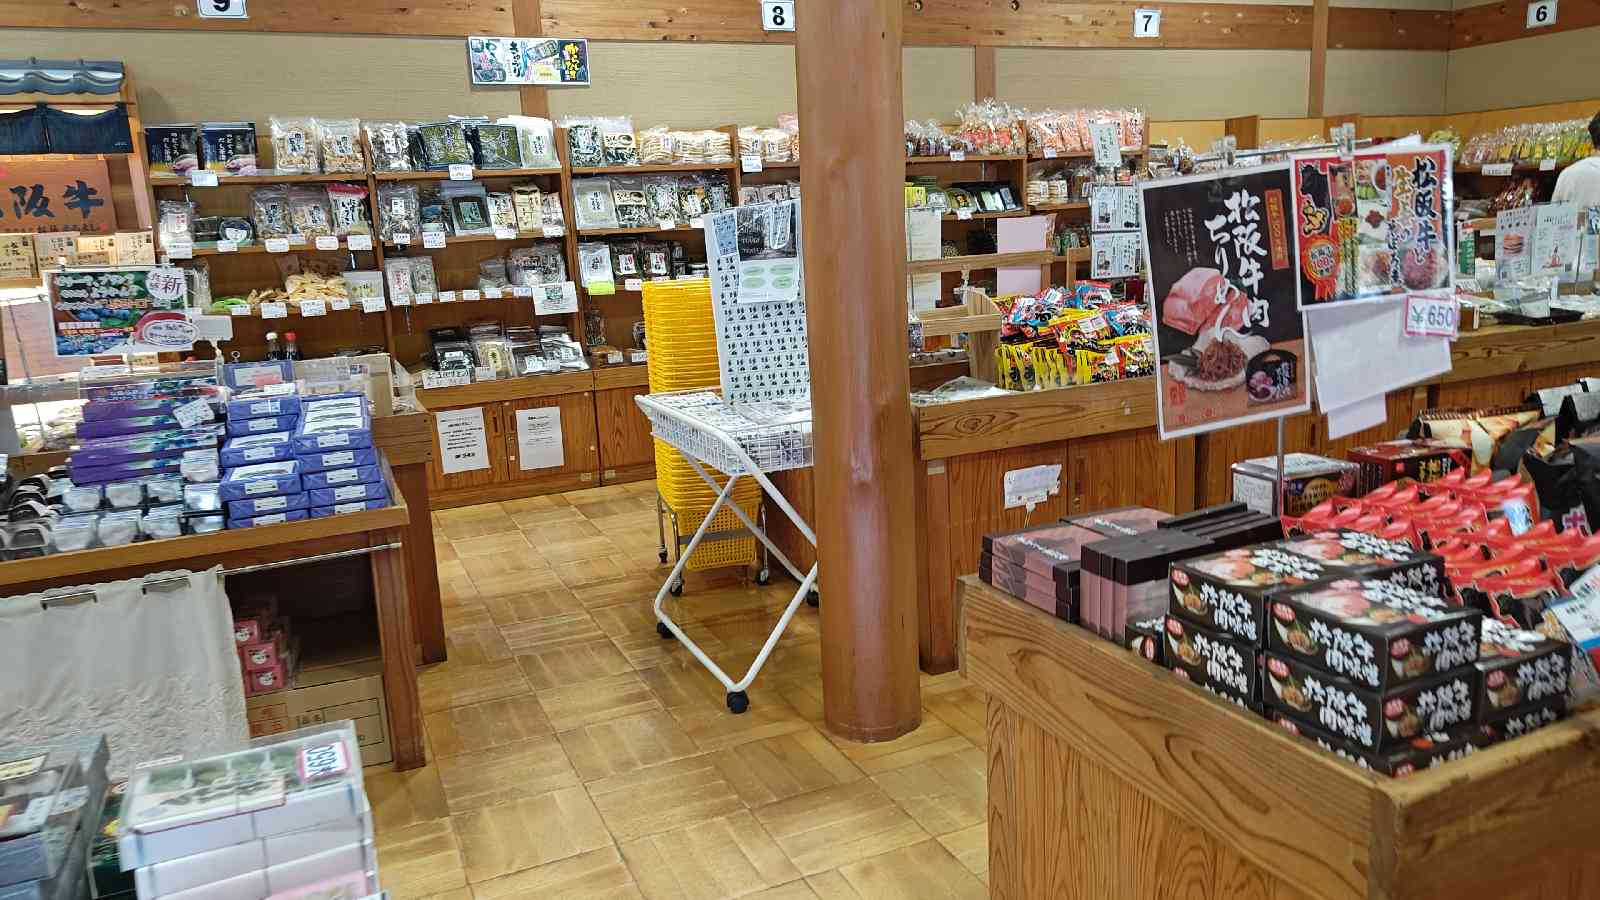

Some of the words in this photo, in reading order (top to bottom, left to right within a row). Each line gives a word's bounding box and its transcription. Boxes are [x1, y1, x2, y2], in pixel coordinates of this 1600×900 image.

[213, 0, 230, 12] 9
[772, 5, 785, 26] 8
[1536, 5, 1548, 22] 6
[1143, 14, 1153, 33] 7
[0, 178, 104, 219] 阪牛
[1223, 188, 1270, 328] 松阪牛肉
